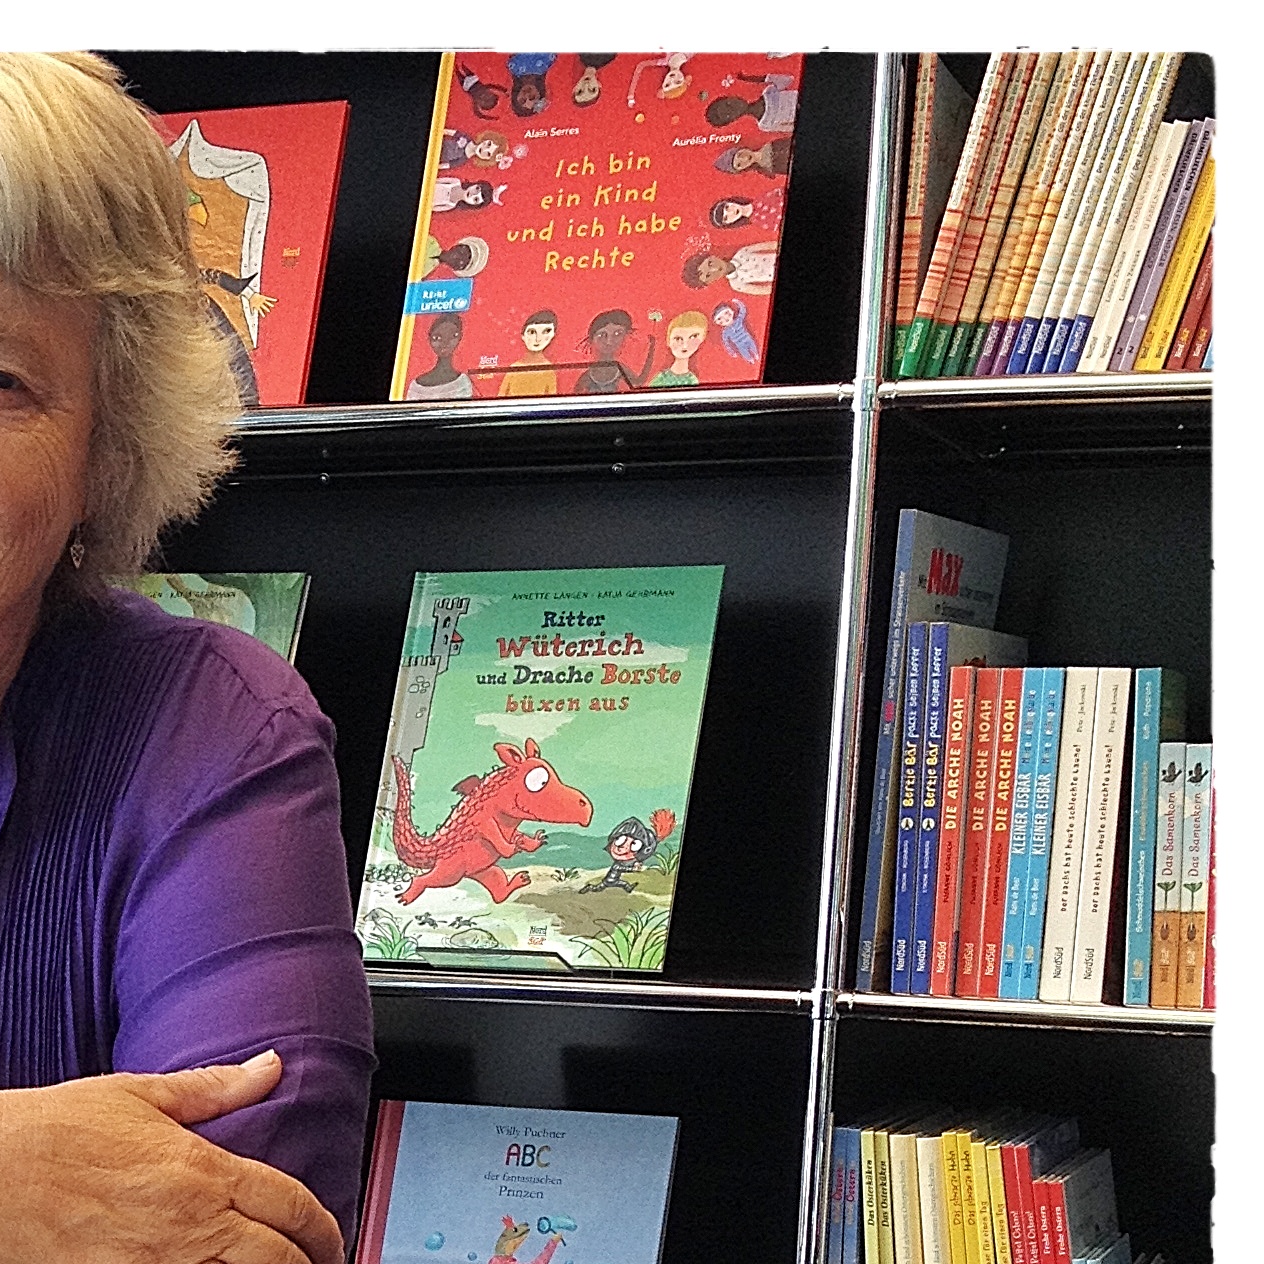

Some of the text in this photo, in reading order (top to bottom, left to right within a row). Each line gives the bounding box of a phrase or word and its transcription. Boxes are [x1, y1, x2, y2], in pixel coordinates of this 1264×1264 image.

[525, 126, 579, 138] Alain Serres
[709, 133, 741, 145] Fronty
[556, 152, 651, 177] Ich bin
[541, 181, 657, 210] ein Kind
[507, 214, 682, 242] und ich habe
[545, 250, 635, 272] Rechte
[421, 298, 454, 310] unicef
[541, 612, 605, 628] Ritter
[497, 633, 644, 658] Wüterich
[477, 664, 681, 684] und Drache Borste
[506, 694, 630, 713] büxen aus
[949, 697, 965, 741] NOAH
[946, 748, 962, 799] ARCHE
[945, 804, 958, 829] DIE
[1011, 812, 1029, 854] KLEINER
[1161, 792, 1178, 877] Das Samenkorn
[495, 1125, 521, 1138] Willy
[506, 1144, 551, 1167] ABC
[484, 1172, 562, 1185] der fantastischen
[499, 1186, 544, 1199] Prinzen
[866, 1210, 875, 1226] Das
